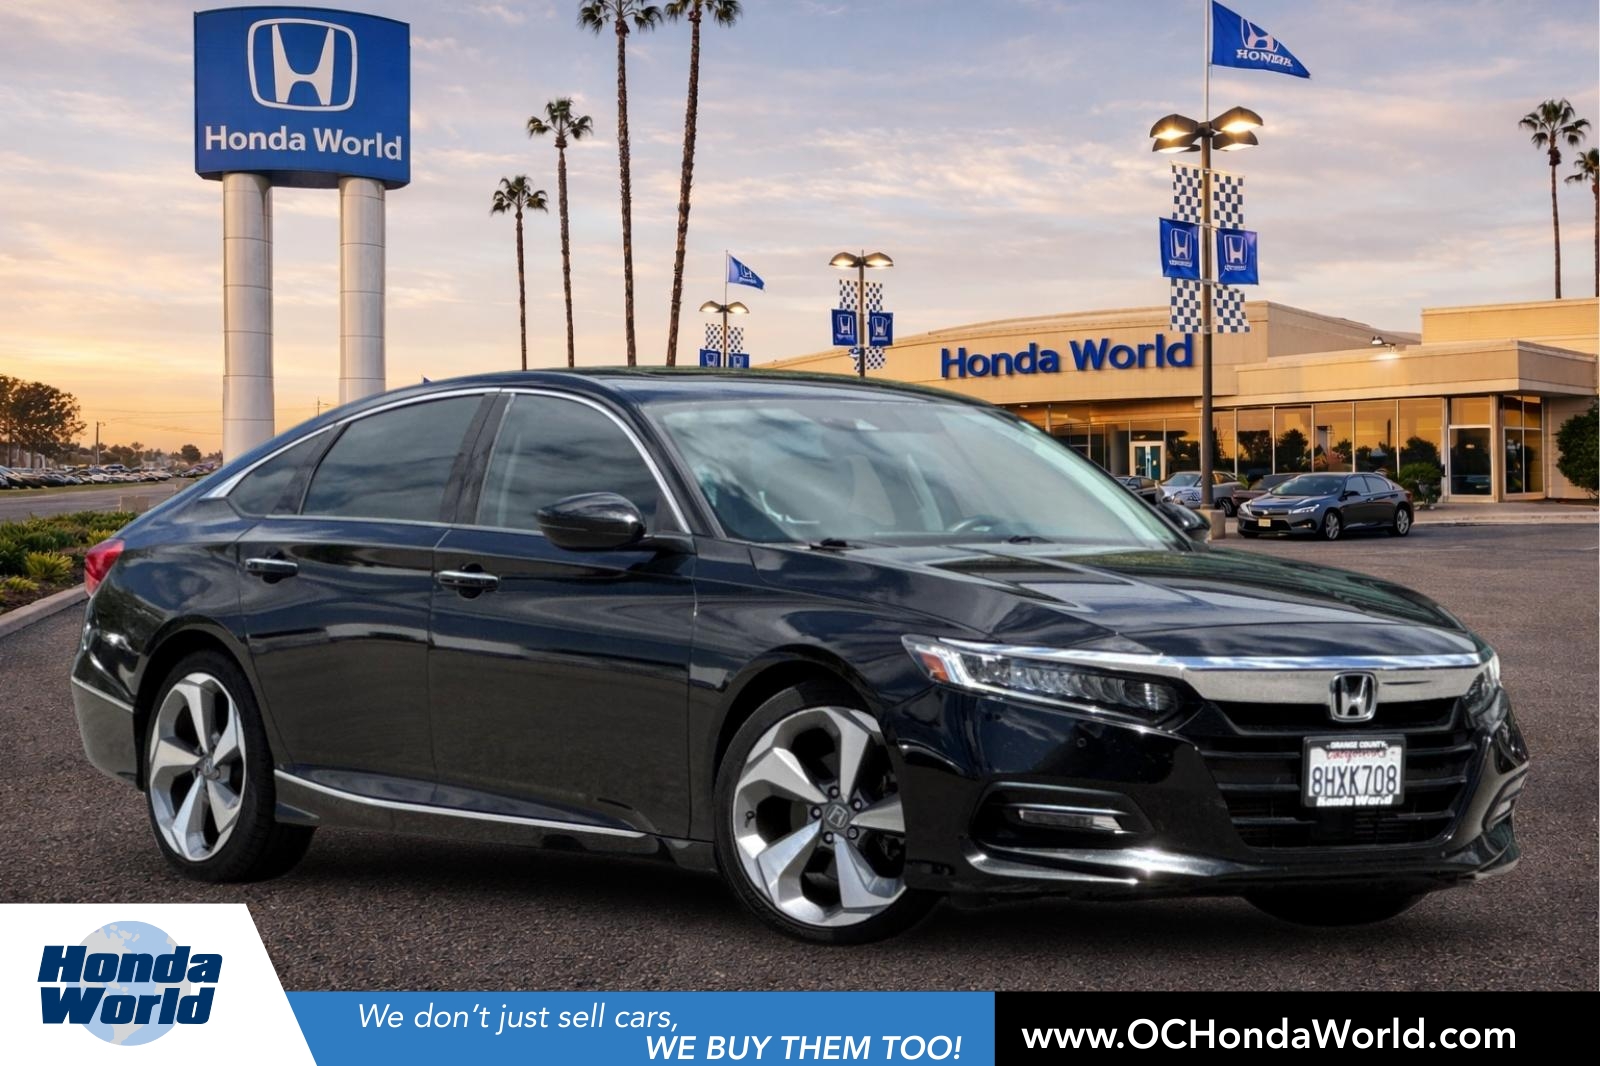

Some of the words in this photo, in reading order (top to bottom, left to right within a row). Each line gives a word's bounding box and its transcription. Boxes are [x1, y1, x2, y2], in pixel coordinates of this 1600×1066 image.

[205, 125, 306, 151] Honda
[313, 127, 402, 160] World
[941, 343, 1061, 378] Honda
[1070, 333, 1194, 371] World
[1311, 764, 1398, 796] 8HXK708
